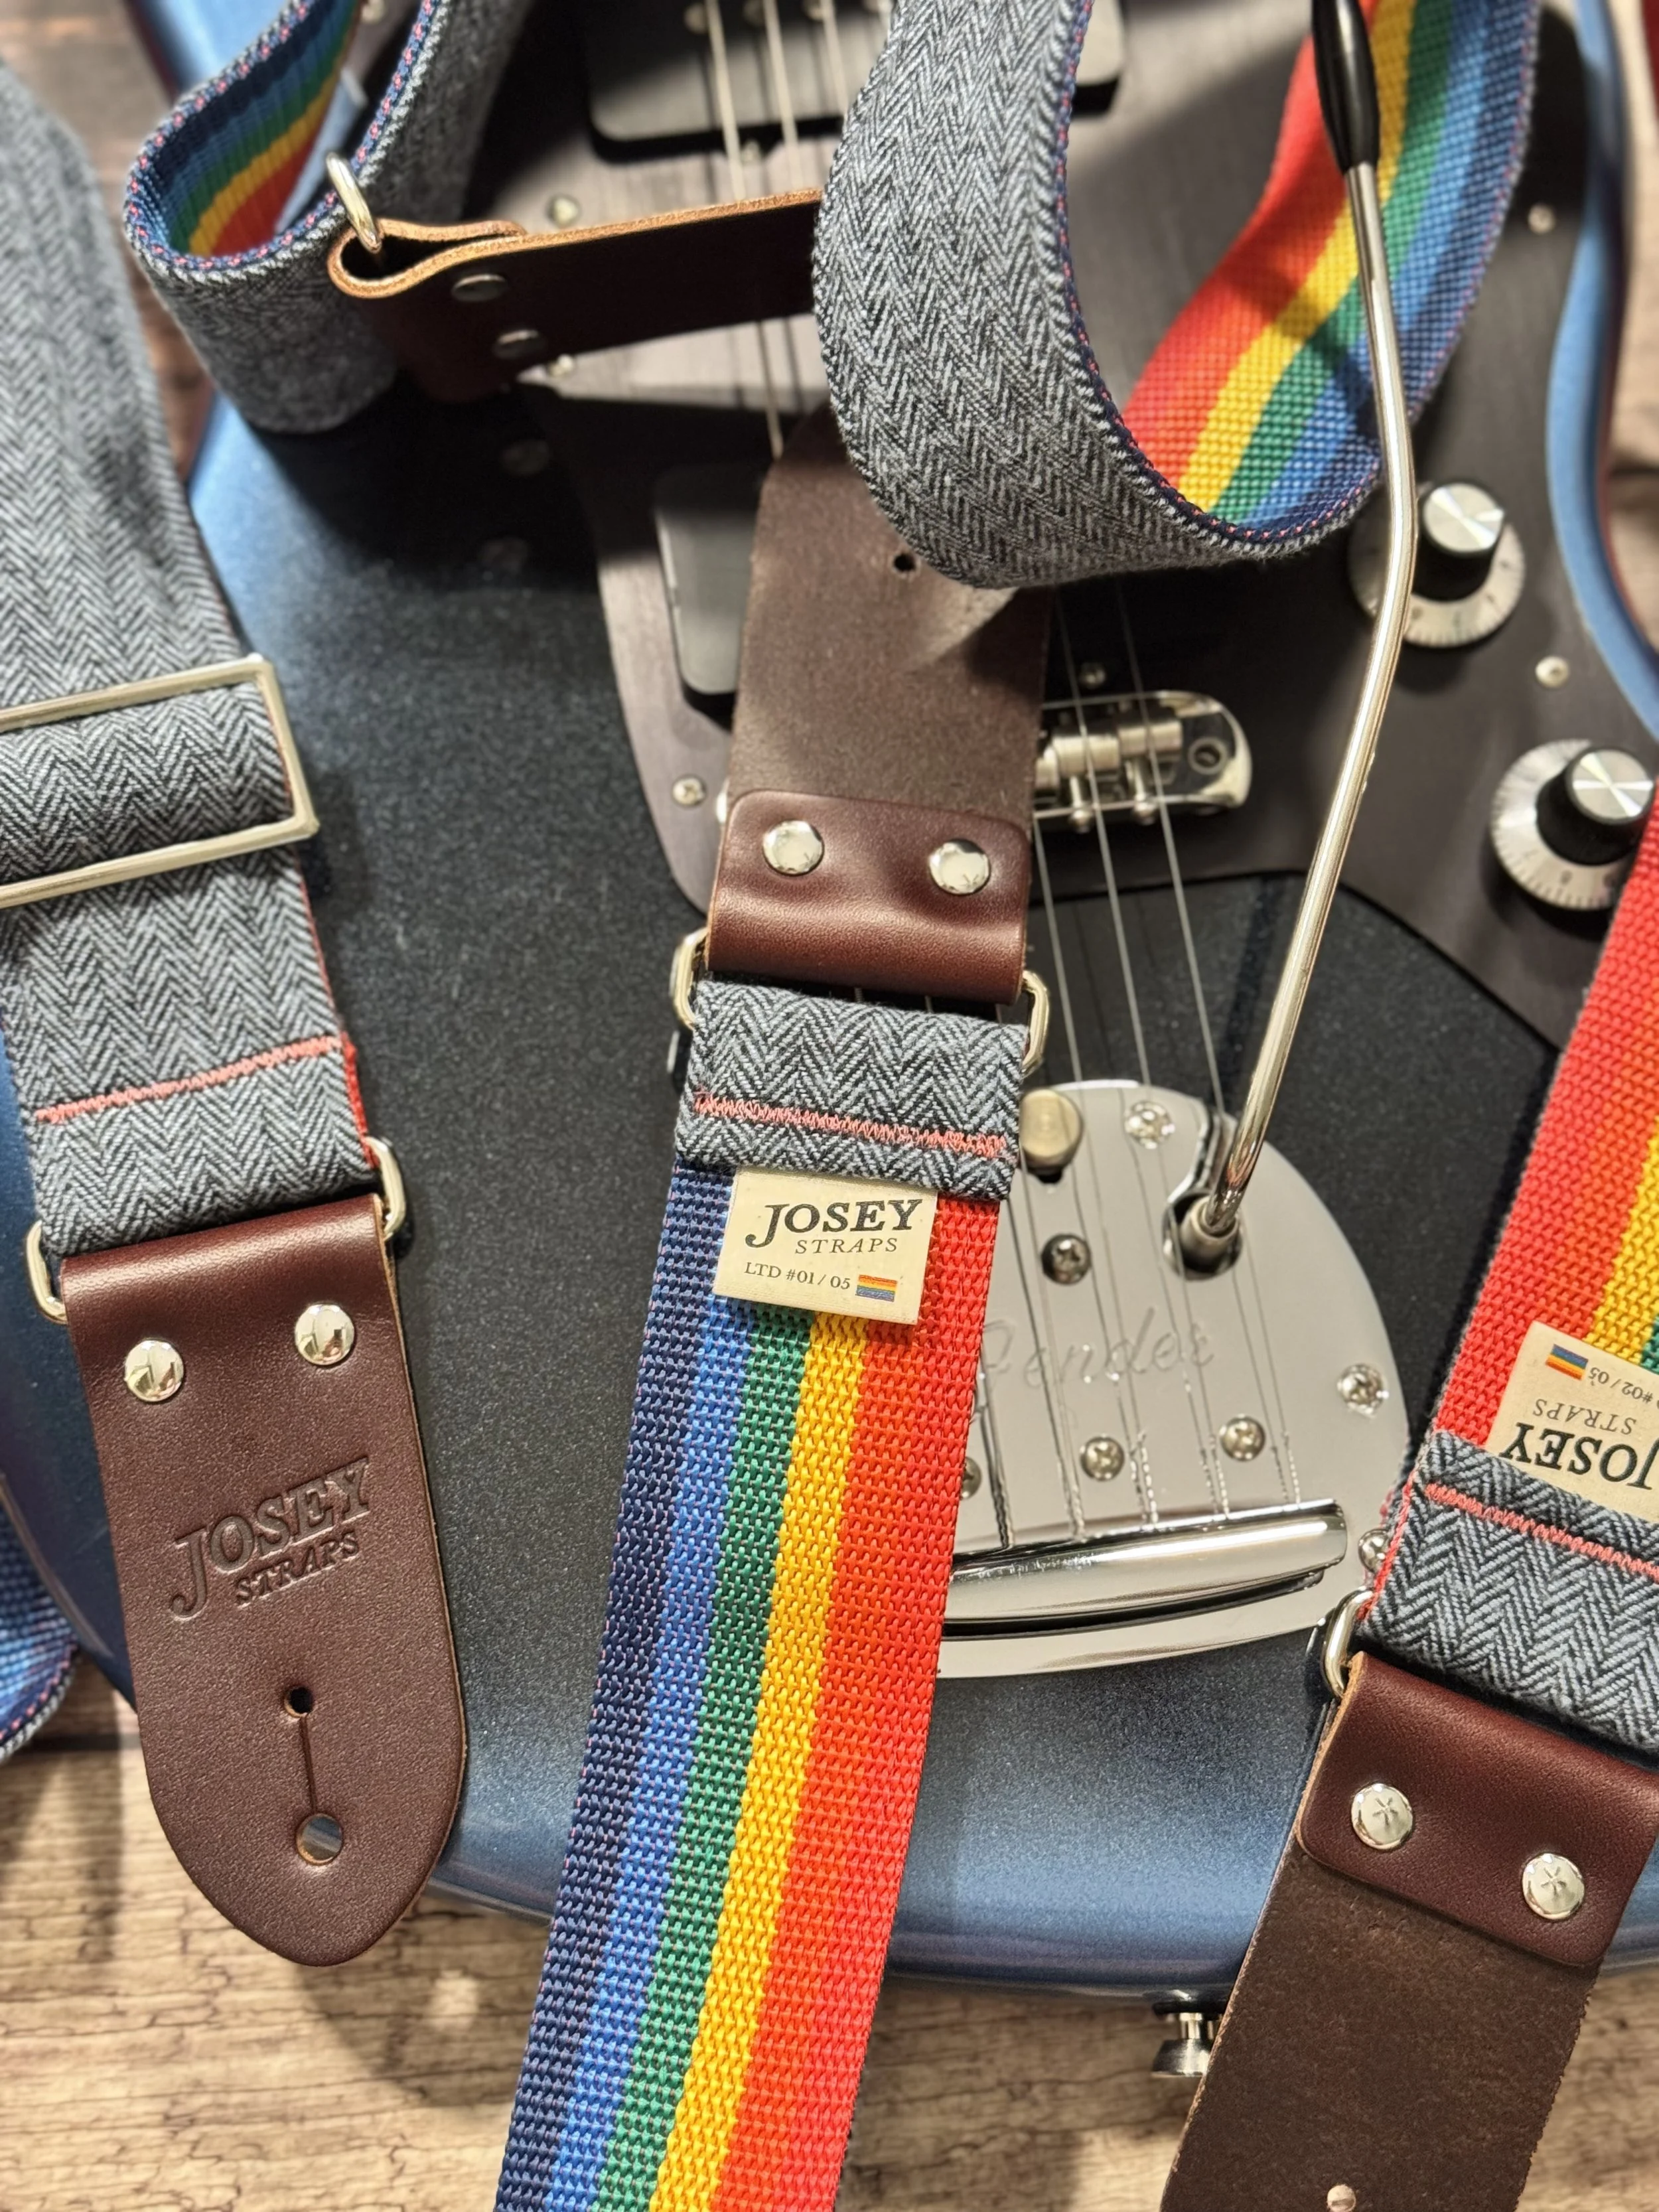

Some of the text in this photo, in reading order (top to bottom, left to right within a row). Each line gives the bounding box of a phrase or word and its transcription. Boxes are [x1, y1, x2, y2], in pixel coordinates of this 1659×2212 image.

[745, 1199, 922, 1248] JOSEY
[795, 1237, 897, 1254] STRAPS
[744, 1262, 781, 1278] LTD
[1533, 1398, 1636, 1435] STRAPS
[170, 1455, 370, 1620] JOSEY
[235, 1531, 359, 1609] STRAPS
